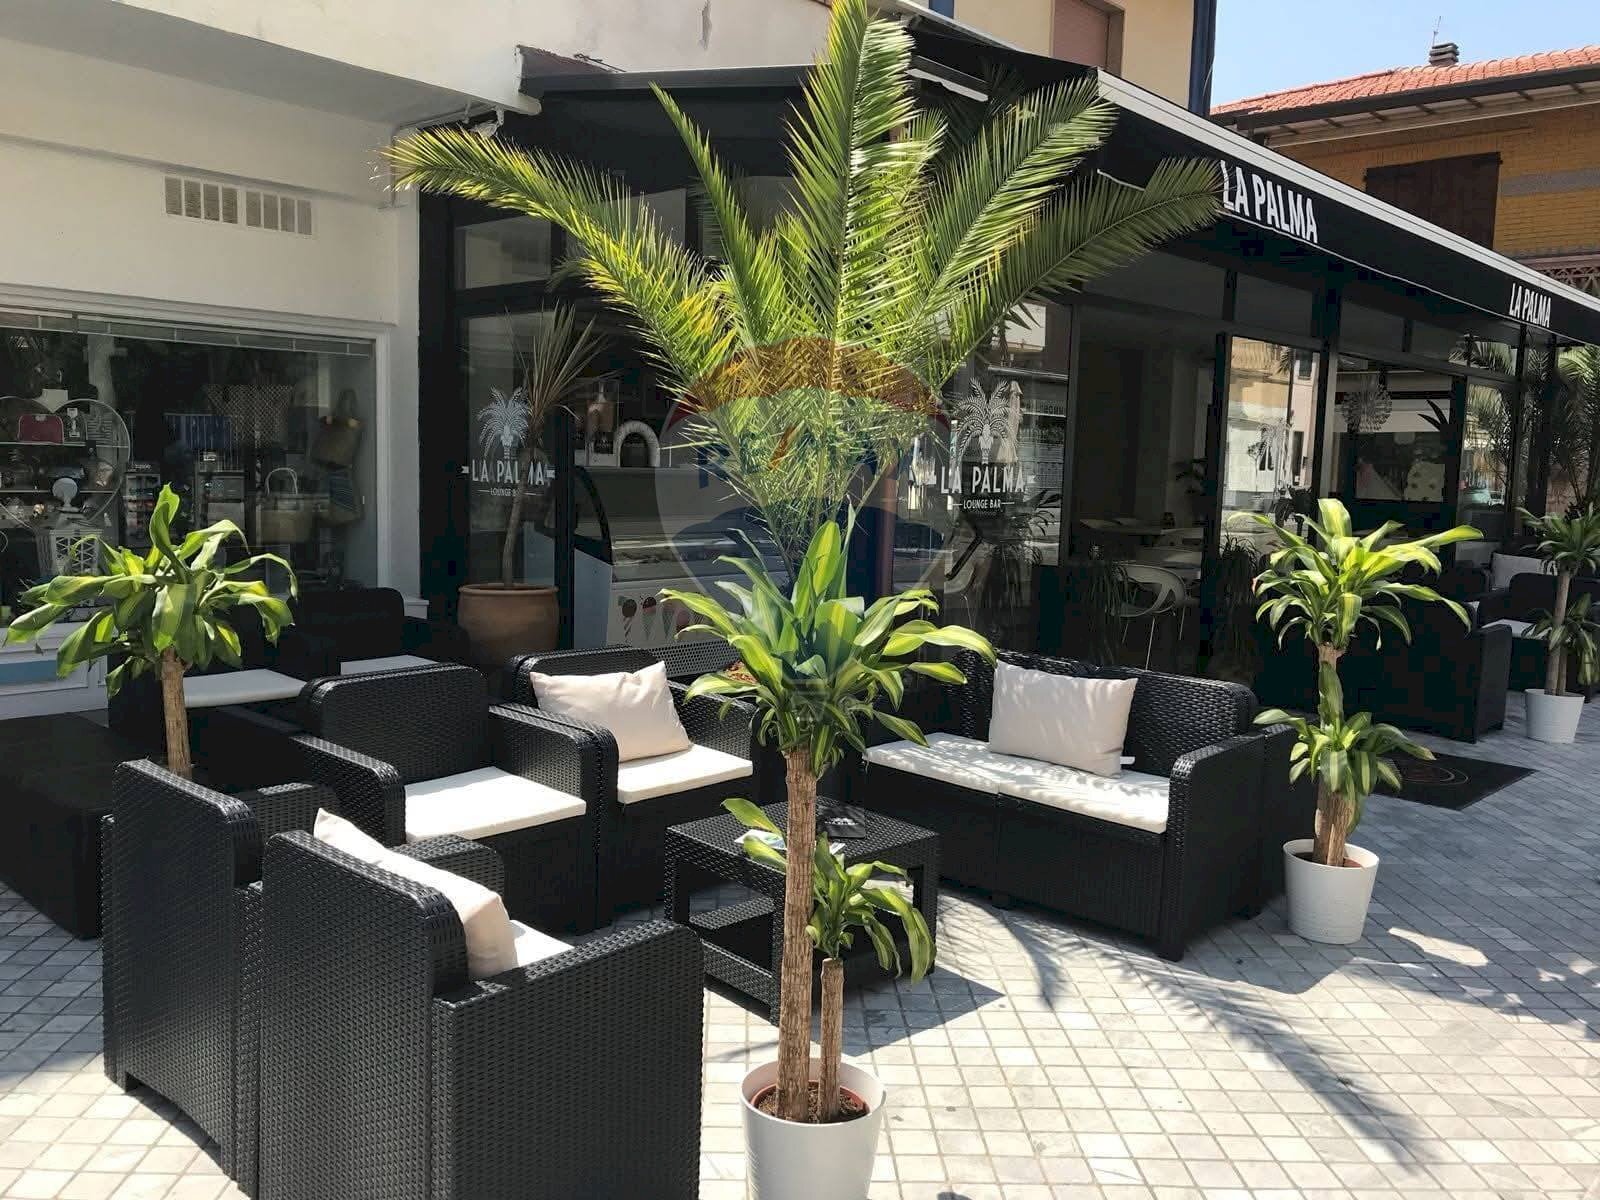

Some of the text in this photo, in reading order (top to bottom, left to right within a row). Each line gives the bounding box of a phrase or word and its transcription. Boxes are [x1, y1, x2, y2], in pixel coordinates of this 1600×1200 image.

[1220, 159, 1318, 244] LA PALMA
[1508, 282, 1551, 328] LA PALMA
[472, 459, 489, 482] LA
[940, 466, 1025, 494] LA PALMA
[963, 499, 1002, 510] LOUNGE BAR
